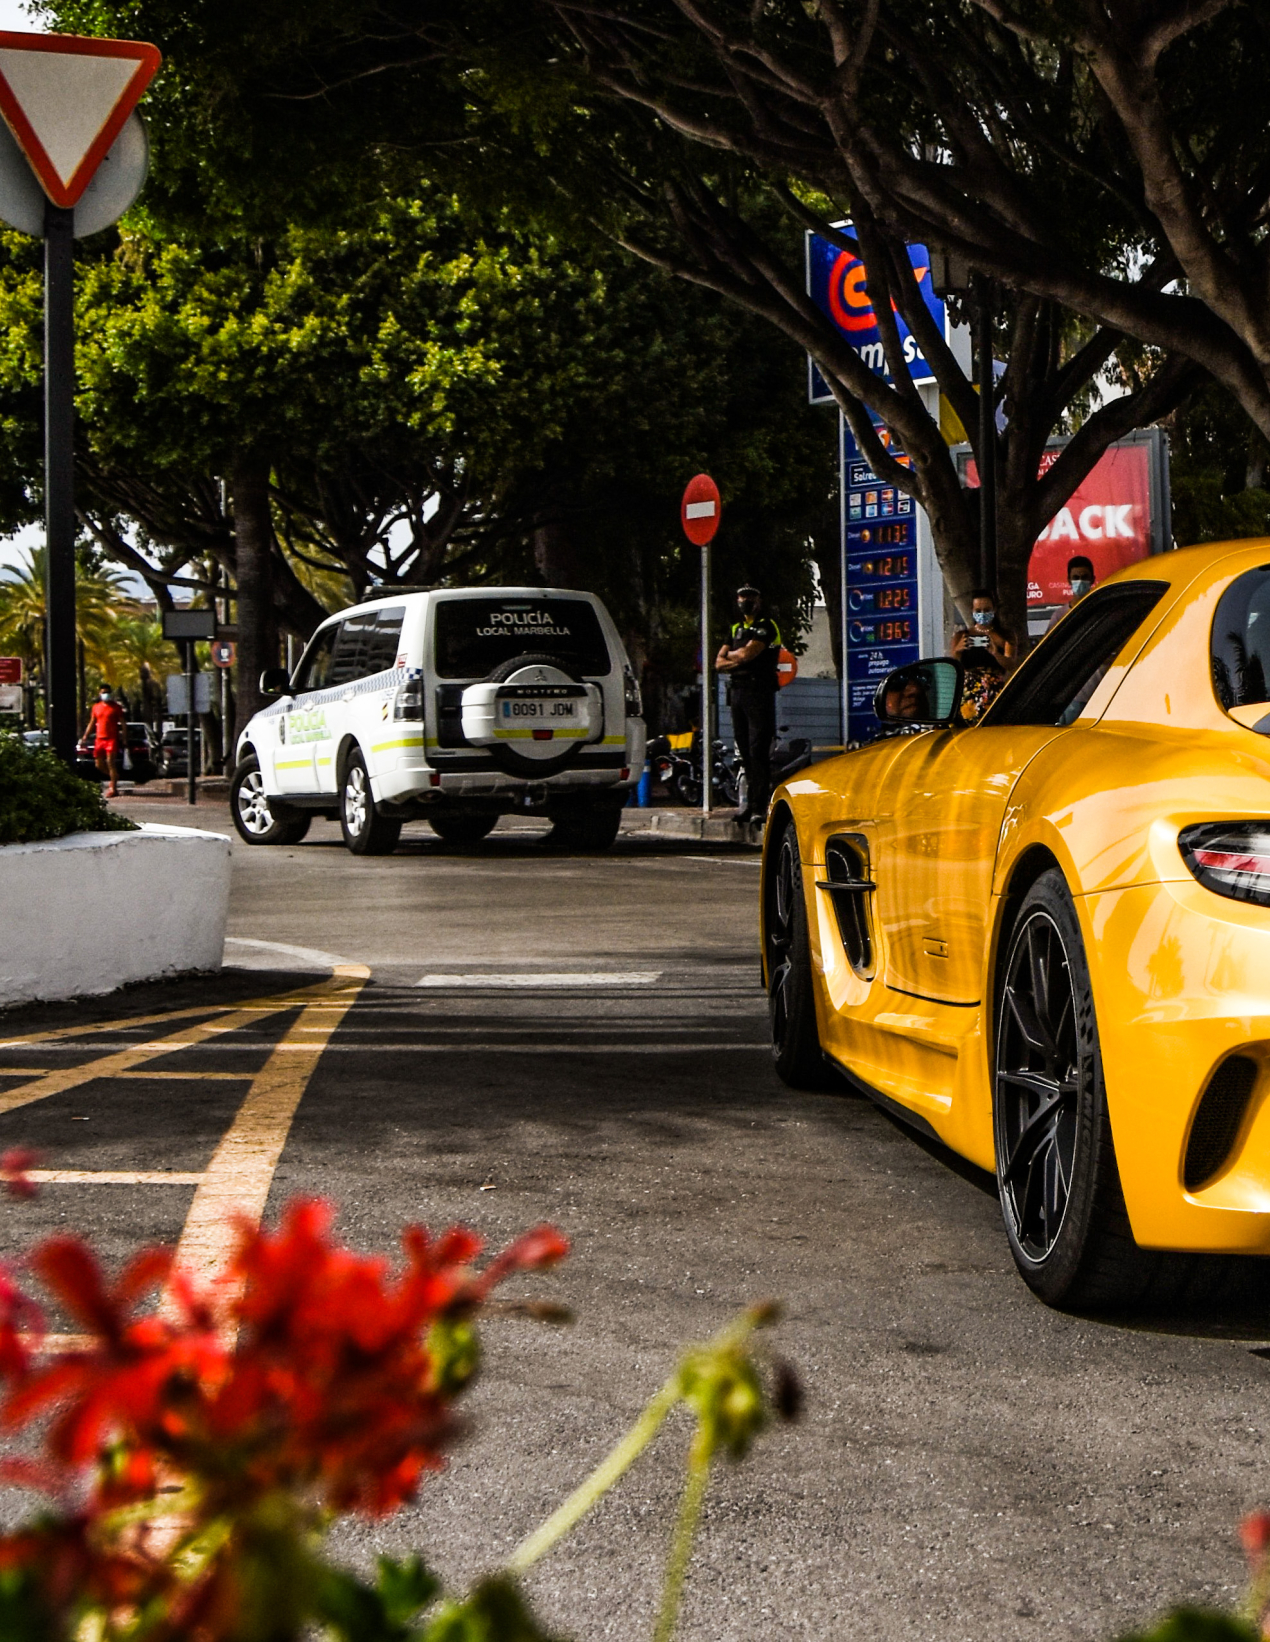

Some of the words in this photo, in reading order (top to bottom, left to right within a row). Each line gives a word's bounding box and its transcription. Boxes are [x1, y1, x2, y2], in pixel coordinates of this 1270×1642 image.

[490, 611, 554, 625] POLICÍA
[476, 627, 511, 636] LOCAL
[514, 626, 571, 636] MARBELLA
[512, 703, 543, 717] 0091
[550, 702, 574, 717] JDM
